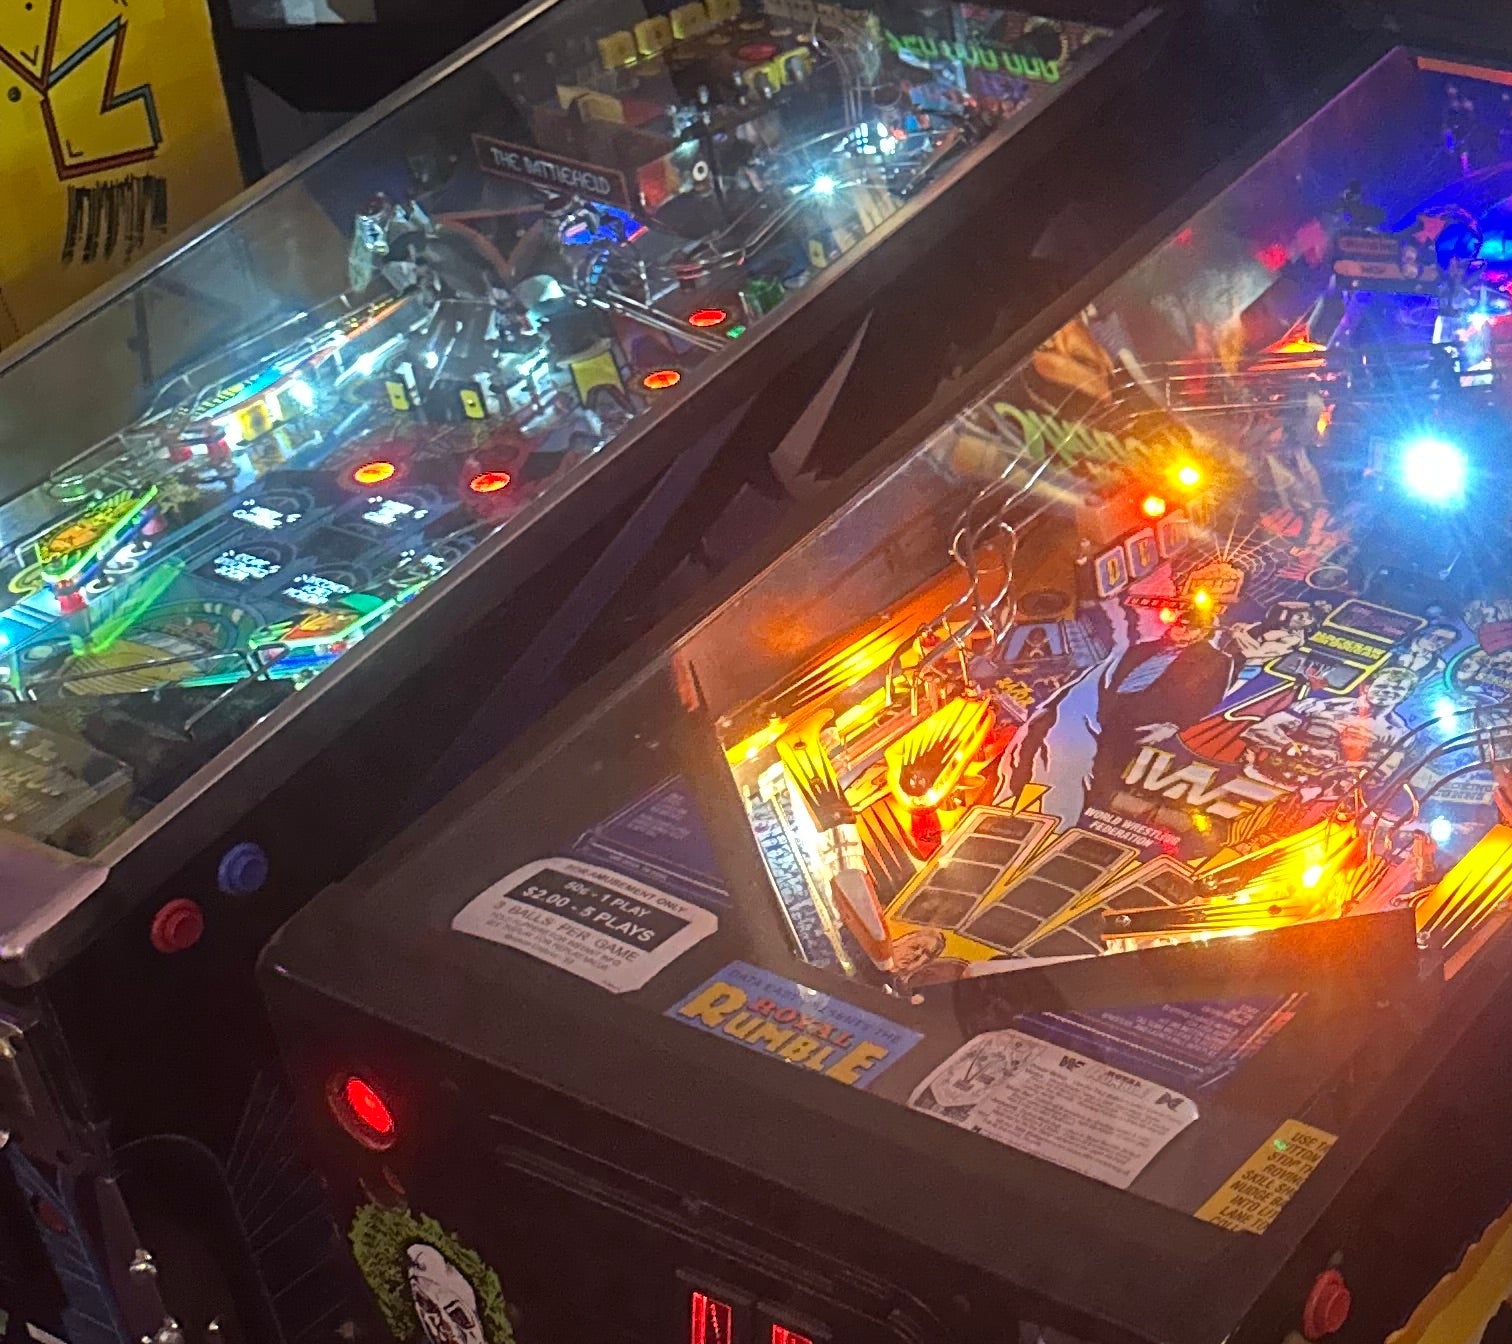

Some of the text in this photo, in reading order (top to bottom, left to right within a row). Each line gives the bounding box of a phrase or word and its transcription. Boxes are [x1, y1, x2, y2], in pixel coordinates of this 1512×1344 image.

[490, 147, 522, 172] THE
[1084, 807, 1122, 827] WORLD
[1089, 821, 1154, 848] FEDERATION
[588, 869, 655, 902] AMUSEMENT
[523, 886, 570, 908] $2.00
[580, 905, 594, 919] 5
[596, 912, 656, 943] PLAYS
[610, 897, 652, 918] PLAY
[507, 905, 555, 928] BALLS
[557, 921, 592, 942] PER
[594, 934, 641, 963] GAME
[749, 997, 855, 1047] ROYAL
[676, 981, 890, 1086] RUMBLE
[1291, 1132, 1317, 1147] USE
[1267, 1151, 1299, 1167] STOP
[1276, 1140, 1321, 1163] UTTON
[1241, 1169, 1275, 1189] SKILL
[1230, 1180, 1271, 1201] NUDGE
[1230, 1195, 1260, 1212] INTO
[1219, 1206, 1250, 1225] LANE
